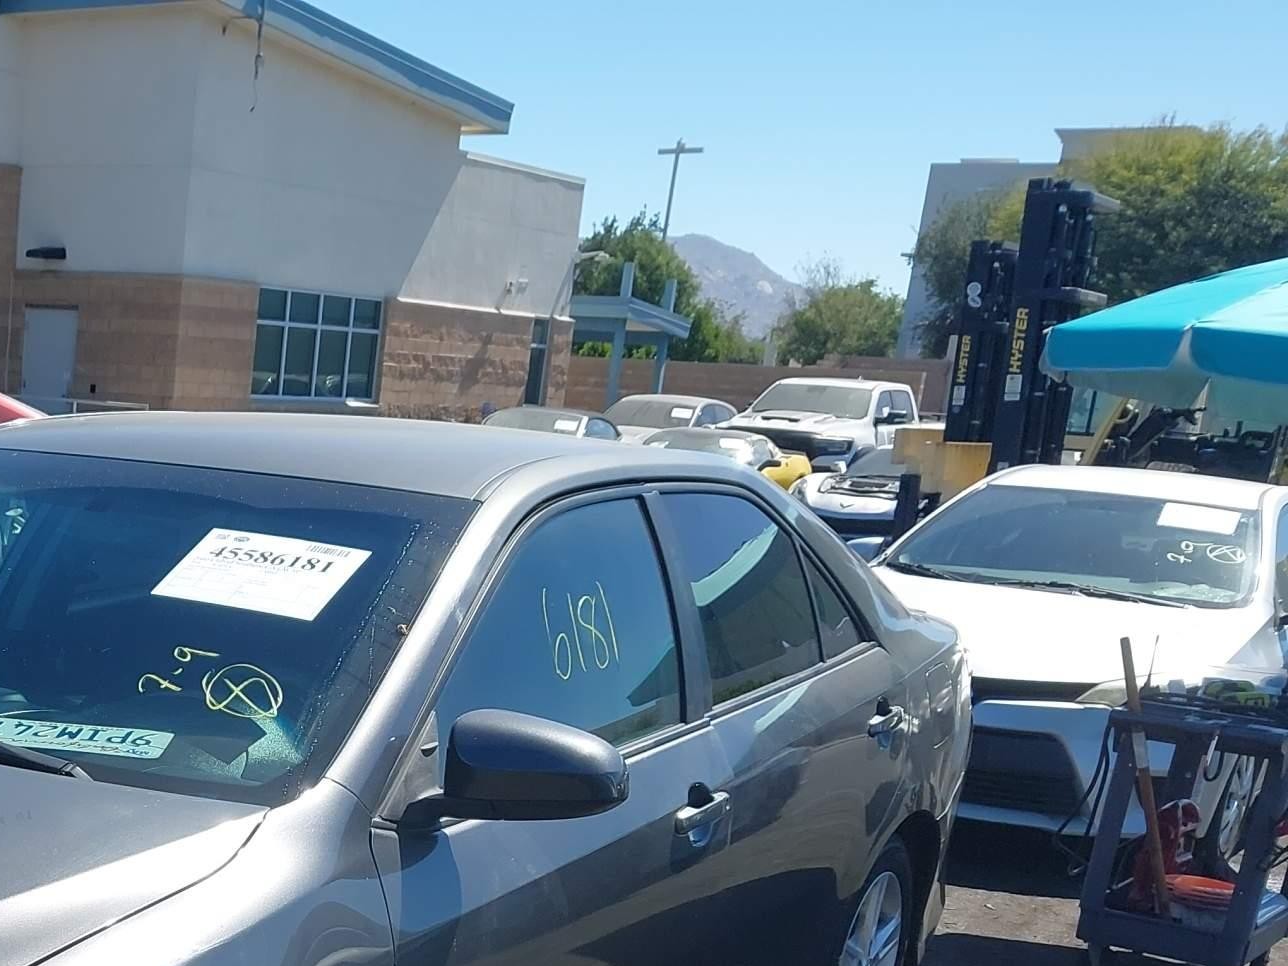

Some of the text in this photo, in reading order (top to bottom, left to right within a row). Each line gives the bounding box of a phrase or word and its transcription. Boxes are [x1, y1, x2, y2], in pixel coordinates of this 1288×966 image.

[955, 335, 972, 384] HYSTER
[1009, 307, 1030, 374] HYSTER
[208, 545, 335, 573] 45586181
[542, 580, 620, 680] 6181
